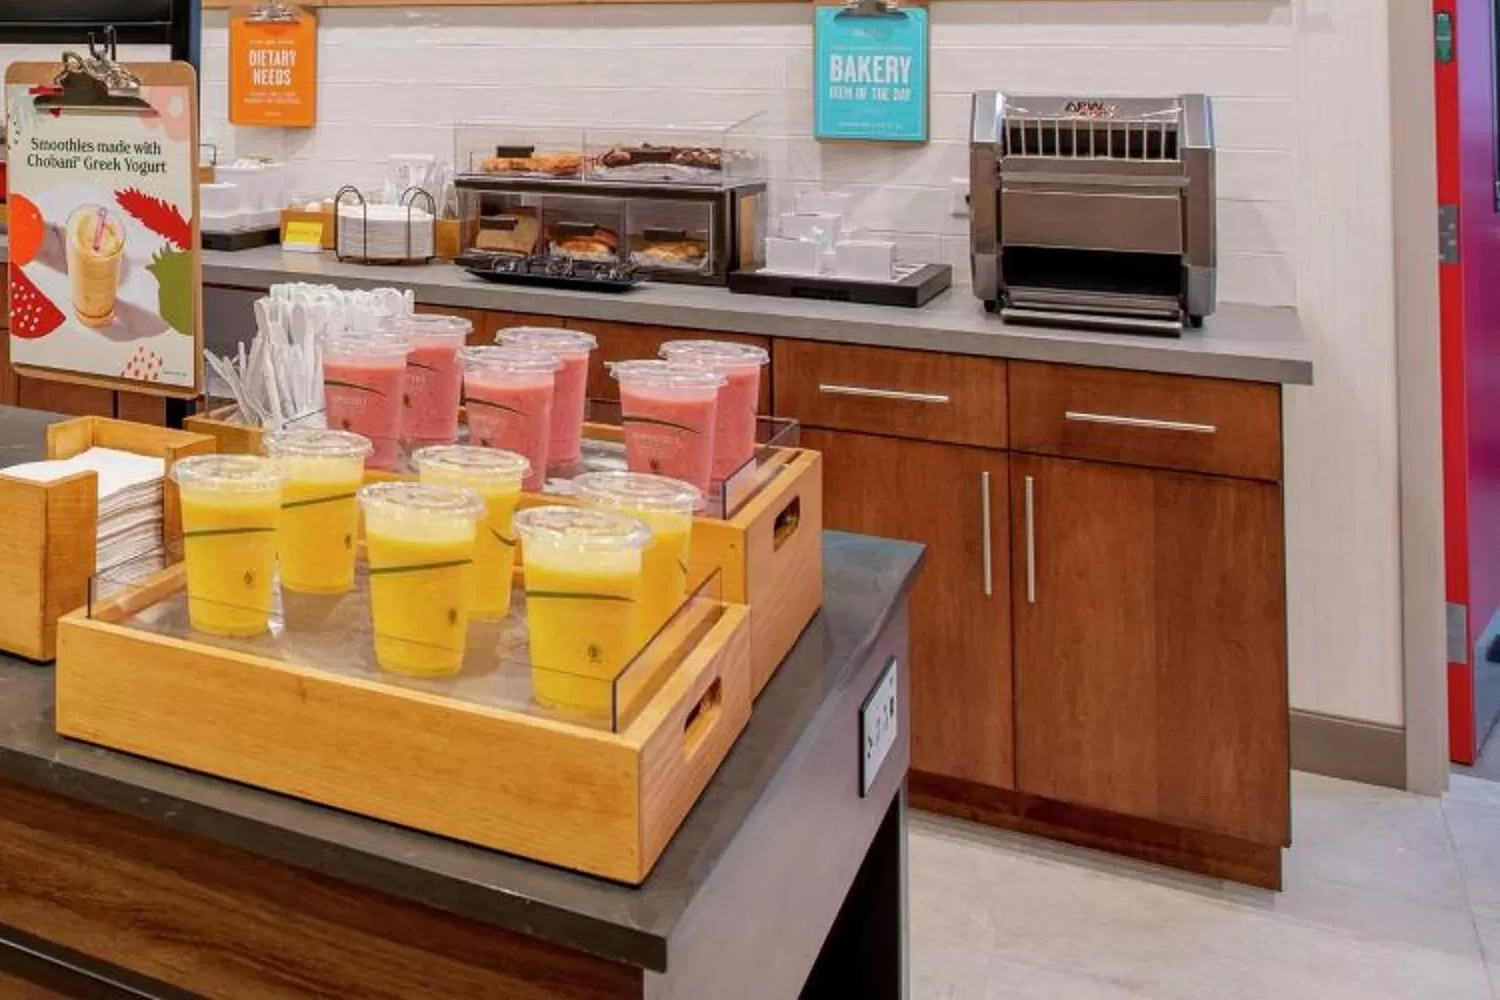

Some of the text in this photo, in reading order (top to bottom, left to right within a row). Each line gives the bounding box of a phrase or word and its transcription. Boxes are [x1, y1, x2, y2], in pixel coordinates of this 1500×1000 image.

[249, 49, 297, 67] DIETARY
[253, 68, 291, 86] NEEDS
[830, 54, 912, 84] BAKERY
[31, 137, 162, 155] Smoothies made with
[83, 157, 121, 171] Greek
[124, 157, 168, 176] Yogurt
